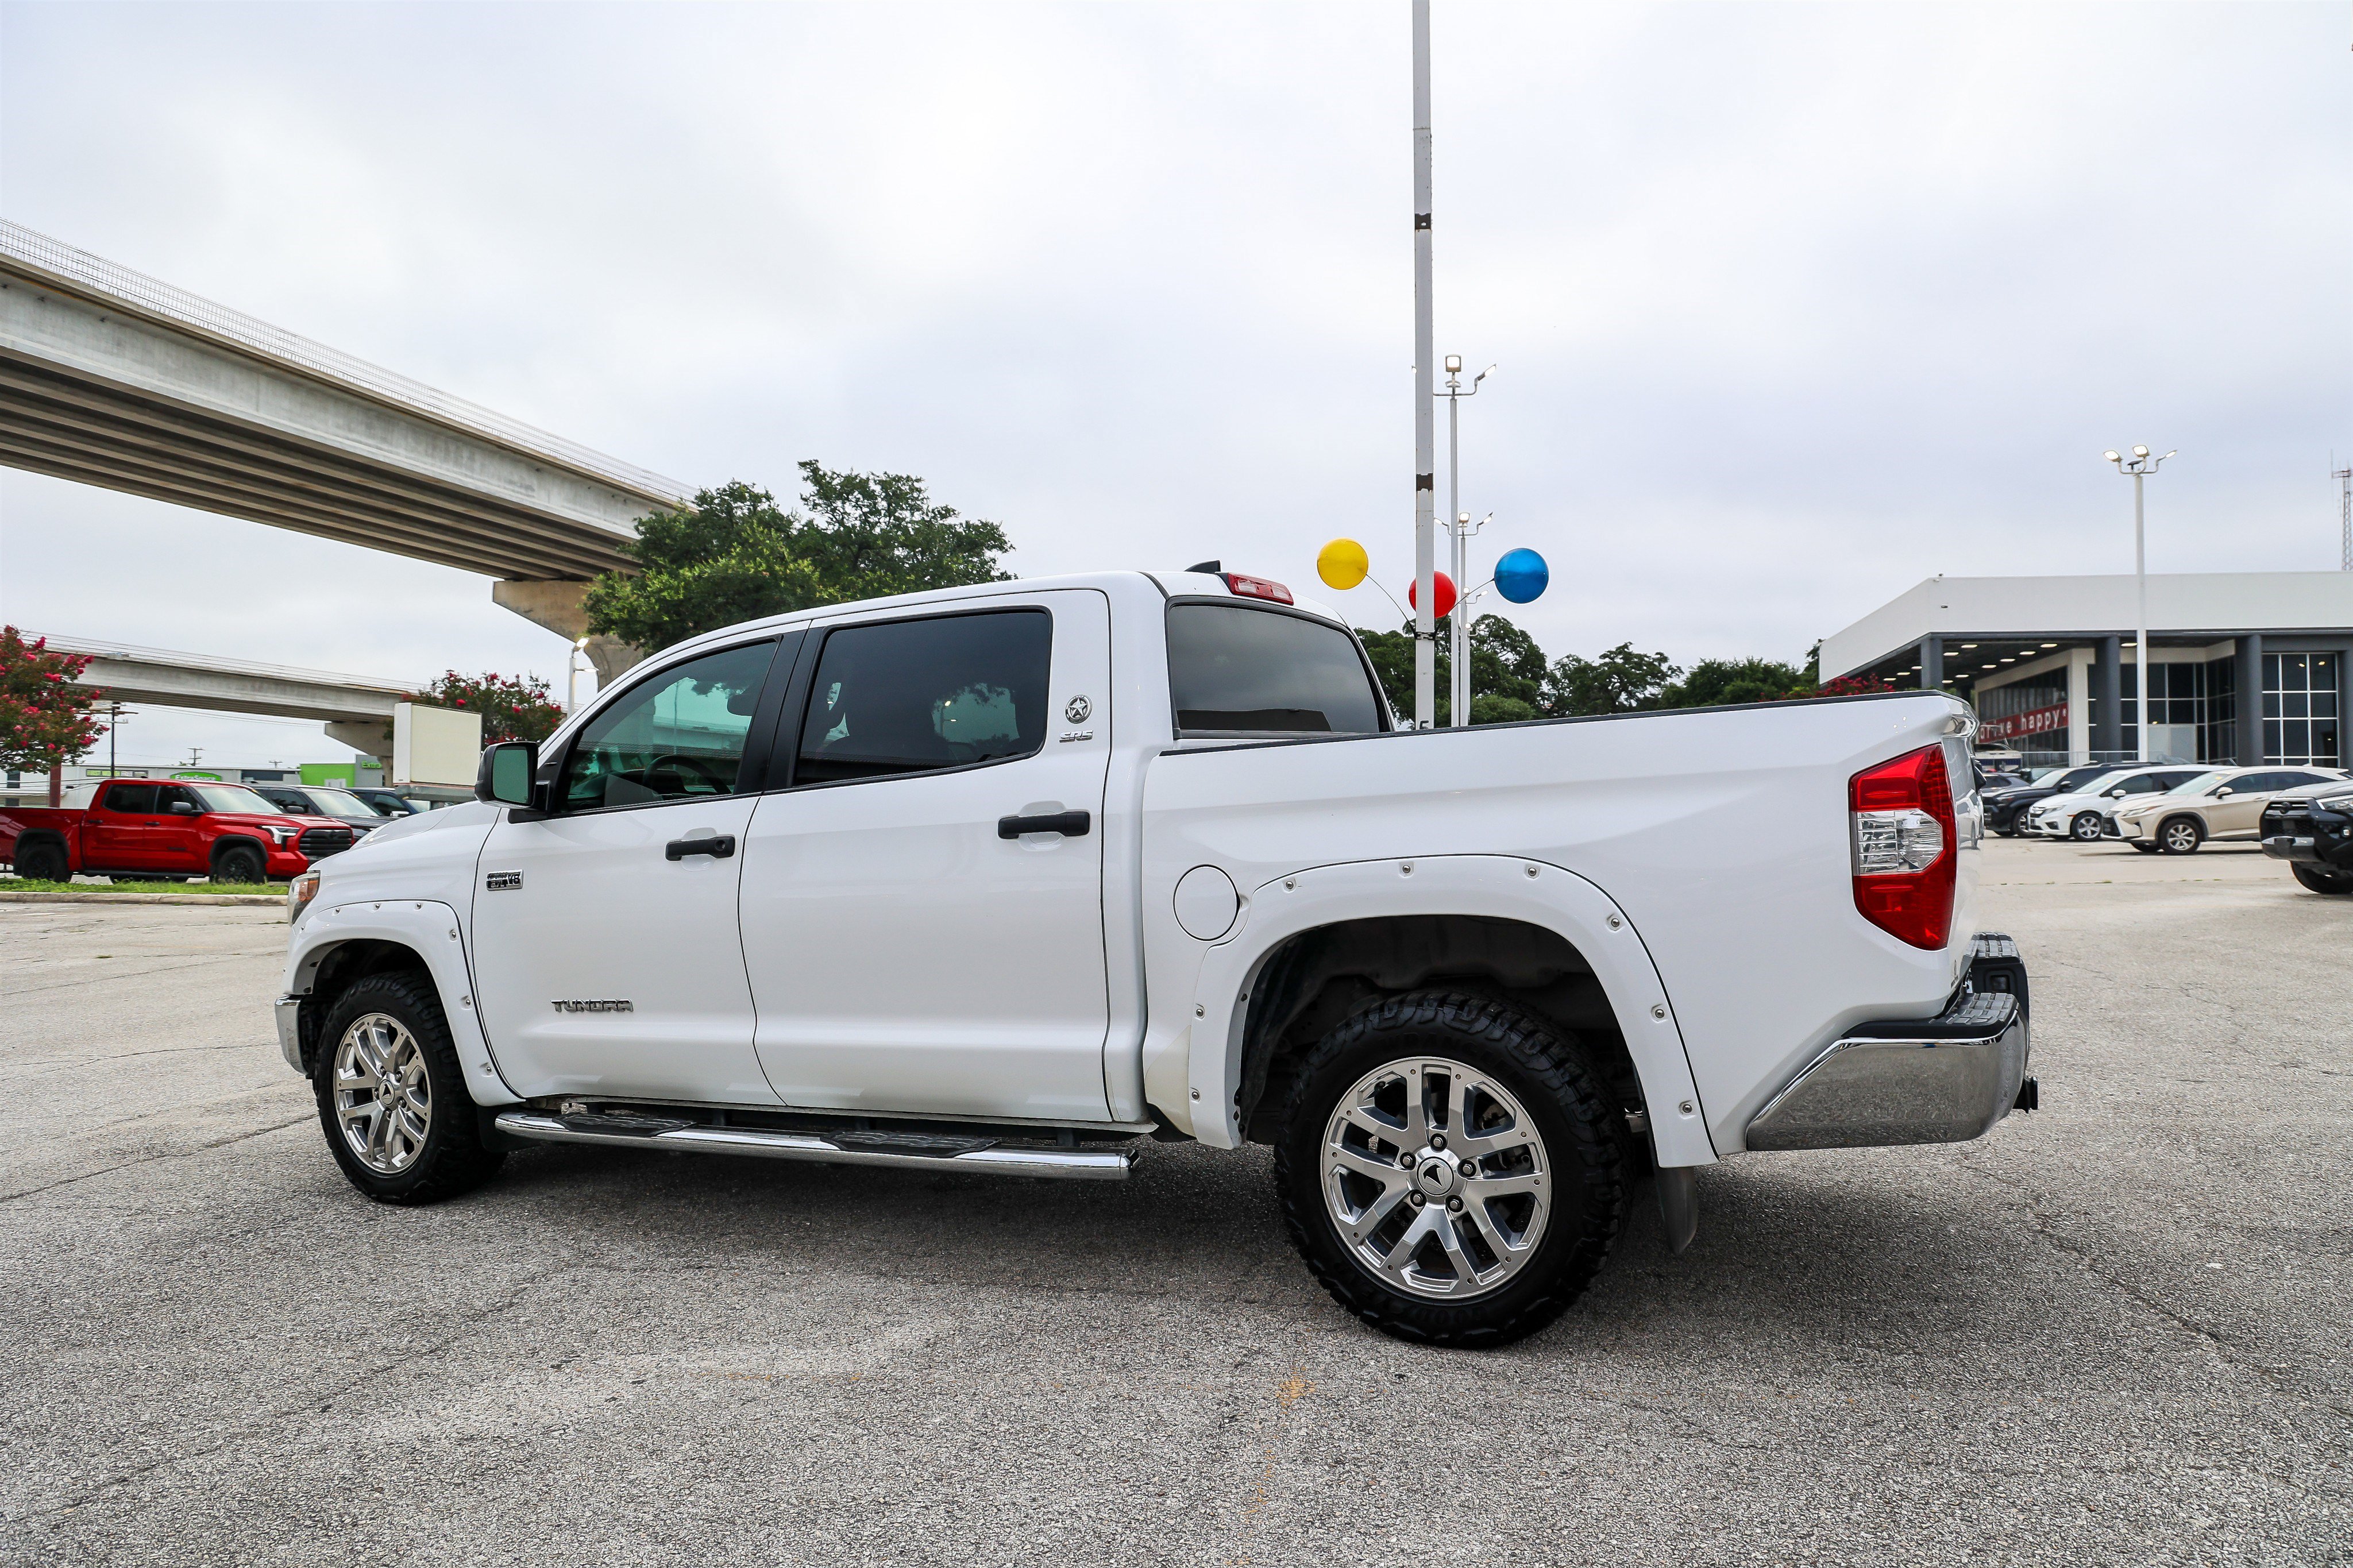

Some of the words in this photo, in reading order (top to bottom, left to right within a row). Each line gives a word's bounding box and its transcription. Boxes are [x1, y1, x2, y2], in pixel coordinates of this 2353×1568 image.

[2021, 709, 2060, 732] happy
[1059, 730, 1093, 743] SR5
[550, 998, 634, 1012] TUNDRA
[1380, 1032, 1527, 1086] WRANGLER
